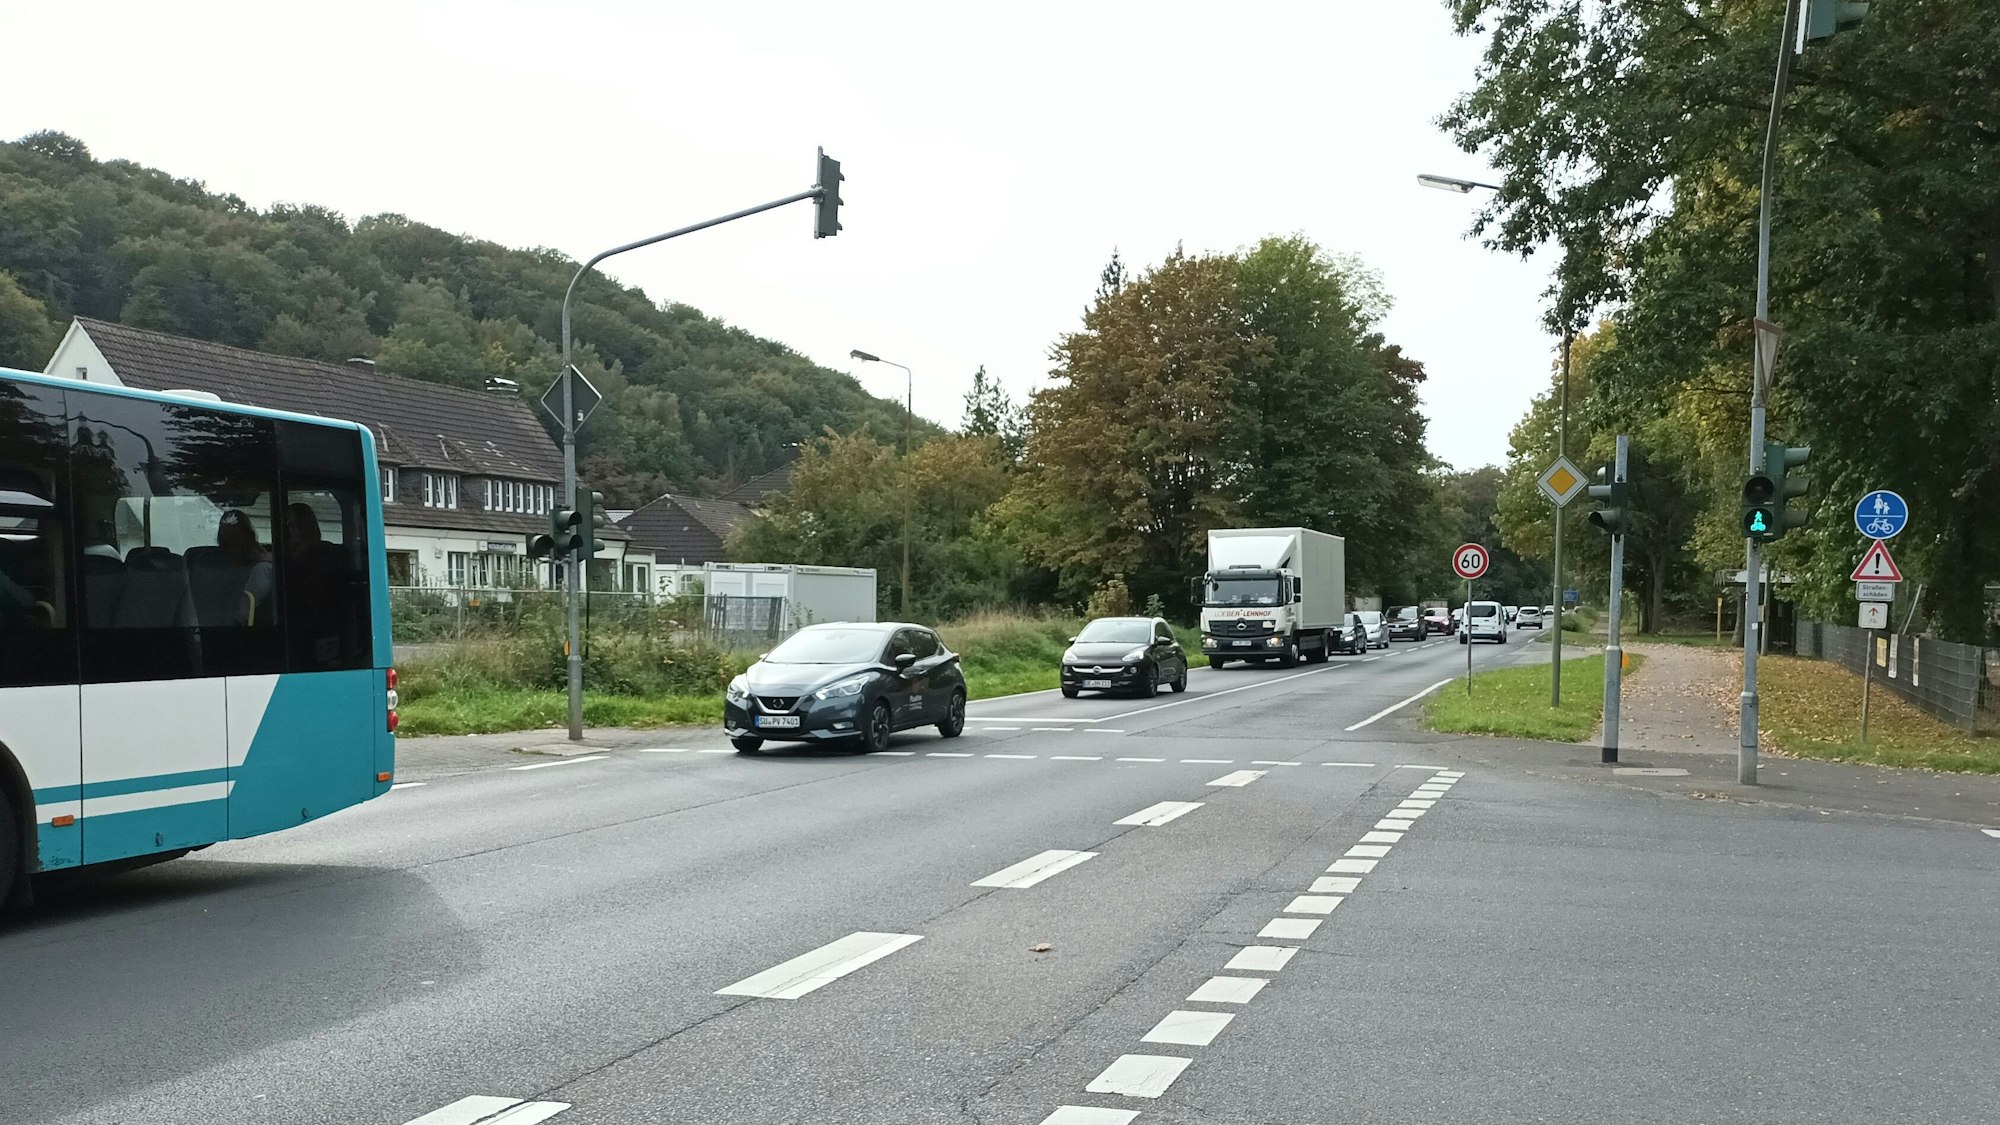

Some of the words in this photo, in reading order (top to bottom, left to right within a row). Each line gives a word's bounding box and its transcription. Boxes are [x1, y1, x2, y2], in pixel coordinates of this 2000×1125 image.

[1462, 554, 1480, 569] 60
[772, 717, 781, 725] PV
[782, 717, 799, 726] 7401
